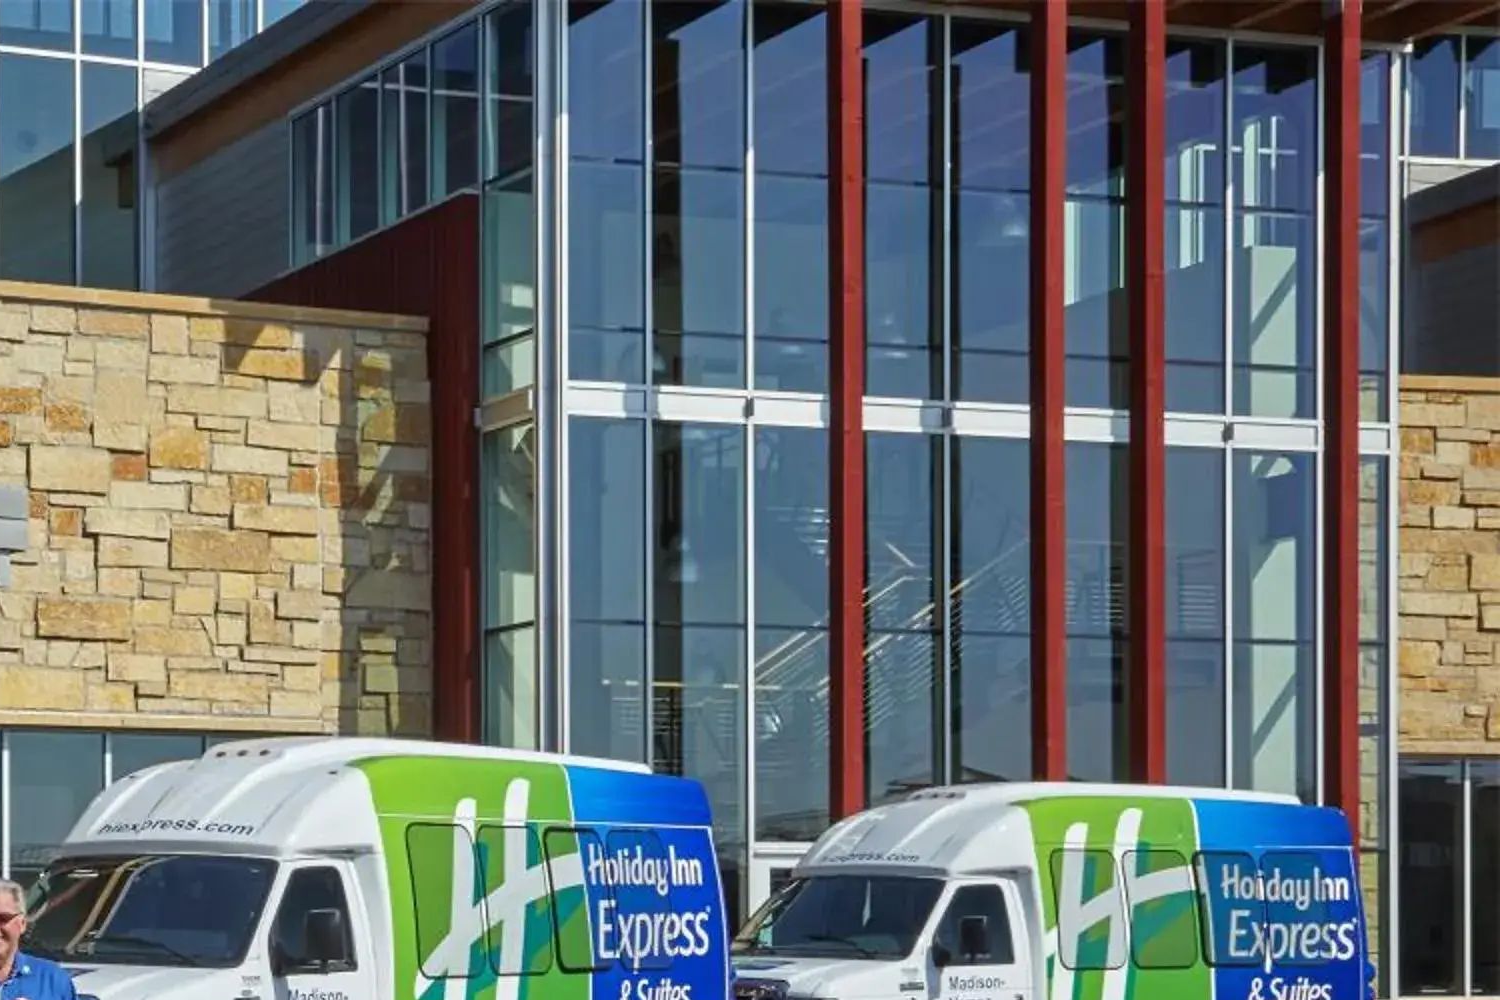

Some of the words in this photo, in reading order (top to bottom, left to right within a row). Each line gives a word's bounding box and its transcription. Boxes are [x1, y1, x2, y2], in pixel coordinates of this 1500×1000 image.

[587, 843, 668, 896] Holiday
[668, 845, 703, 886] Inn
[1313, 866, 1349, 902] Inn
[597, 899, 710, 974] Express
[1228, 909, 1355, 974] Express
